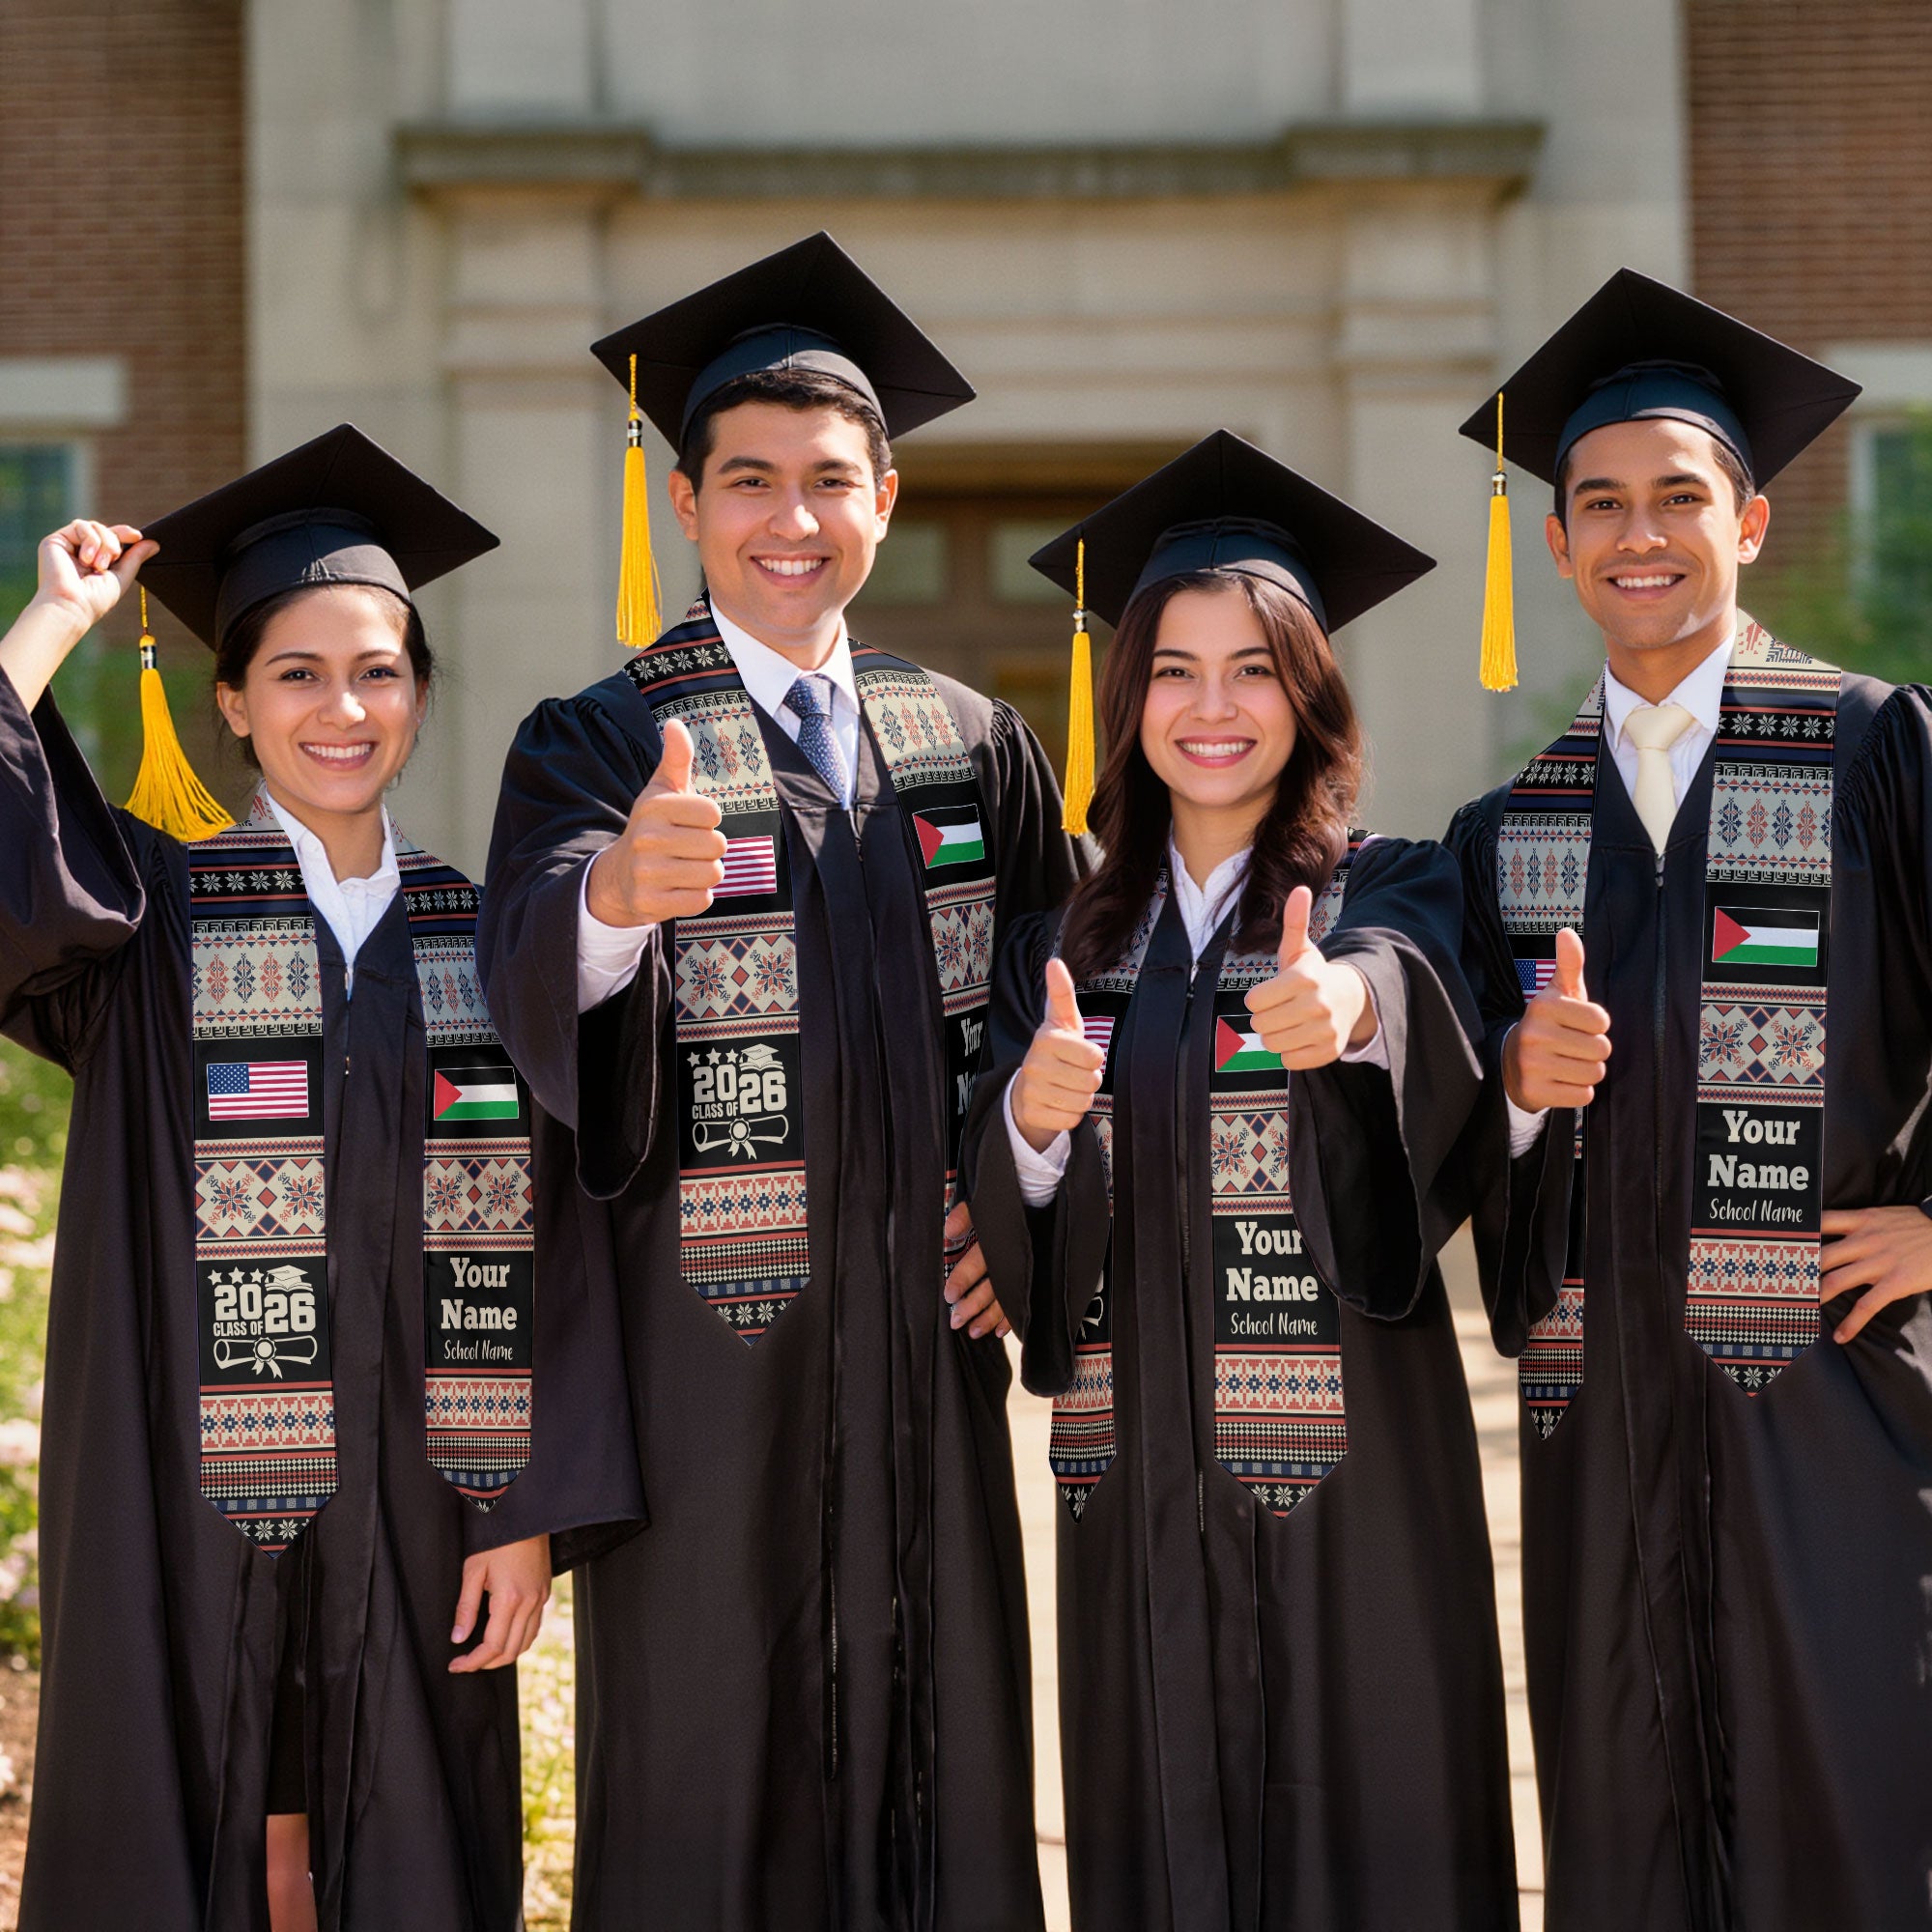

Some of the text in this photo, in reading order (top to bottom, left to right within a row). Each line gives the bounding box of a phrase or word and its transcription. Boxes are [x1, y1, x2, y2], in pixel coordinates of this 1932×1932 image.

[960, 1017, 983, 1057] Your
[693, 1064, 787, 1114] 2026
[692, 1101, 739, 1120] CLASS OF
[1722, 1110, 1801, 1145] Your
[1707, 1154, 1809, 1191] Name
[1709, 1198, 1804, 1223] School Name
[1235, 1221, 1303, 1255] Your
[449, 1257, 511, 1288] Your
[1226, 1267, 1319, 1301] Name
[213, 1283, 317, 1333] 2026
[440, 1298, 518, 1330] Name
[1231, 1312, 1319, 1336] School Name
[213, 1321, 264, 1337] CLASS OF
[444, 1339, 514, 1361] School Name
